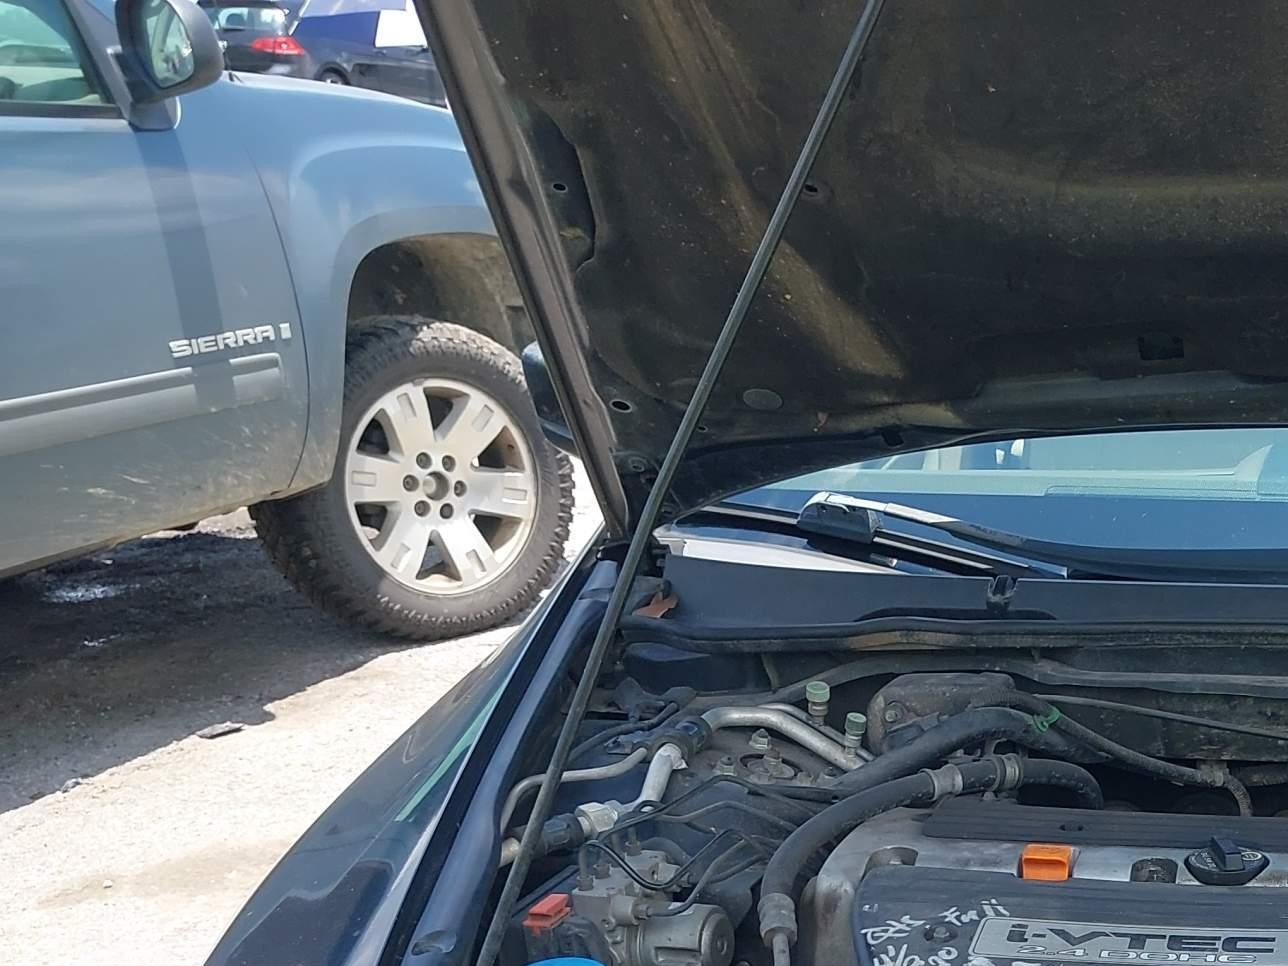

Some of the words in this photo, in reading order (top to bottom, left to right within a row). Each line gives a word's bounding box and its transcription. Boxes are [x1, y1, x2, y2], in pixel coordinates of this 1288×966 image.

[168, 325, 276, 359] SIERRA
[1006, 923, 1276, 953] i-VTEC
[1015, 944, 1088, 957] 2.4
[1099, 949, 1257, 964] DOHC
